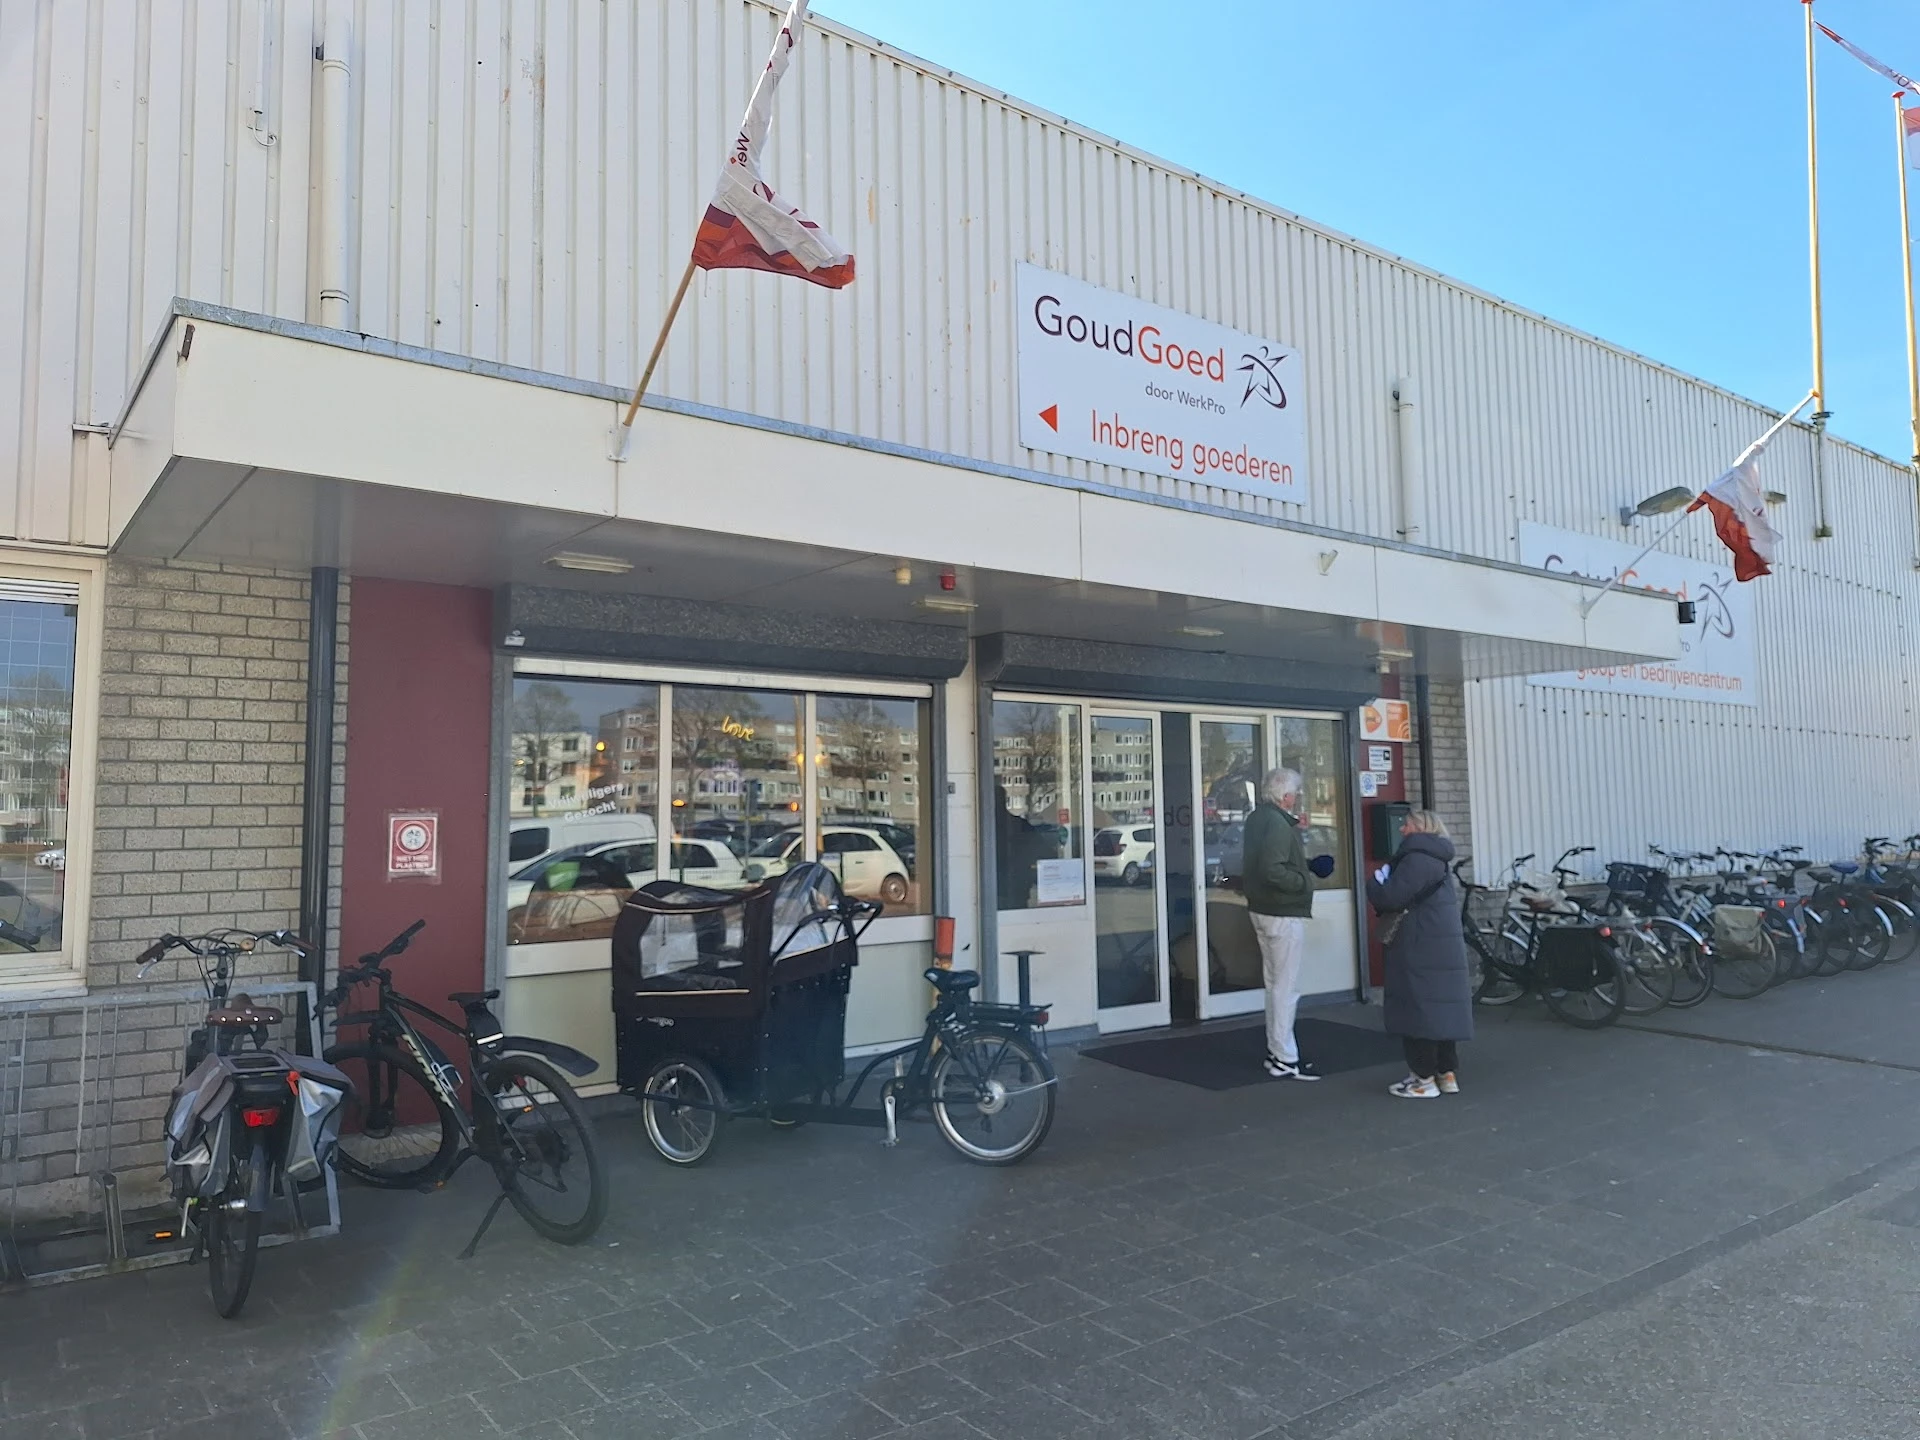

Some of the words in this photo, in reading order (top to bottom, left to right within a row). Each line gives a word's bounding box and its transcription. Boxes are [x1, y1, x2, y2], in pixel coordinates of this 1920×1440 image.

[1034, 295, 1225, 383] GoudGoed
[1145, 382, 1174, 401] door
[1177, 389, 1226, 415] WerkPro
[1092, 409, 1184, 470] Inbreng
[1192, 443, 1293, 485] goederen
[1621, 663, 1637, 679] en
[1641, 662, 1743, 691] bedrijvencentrum
[565, 800, 617, 822] Gezocht
